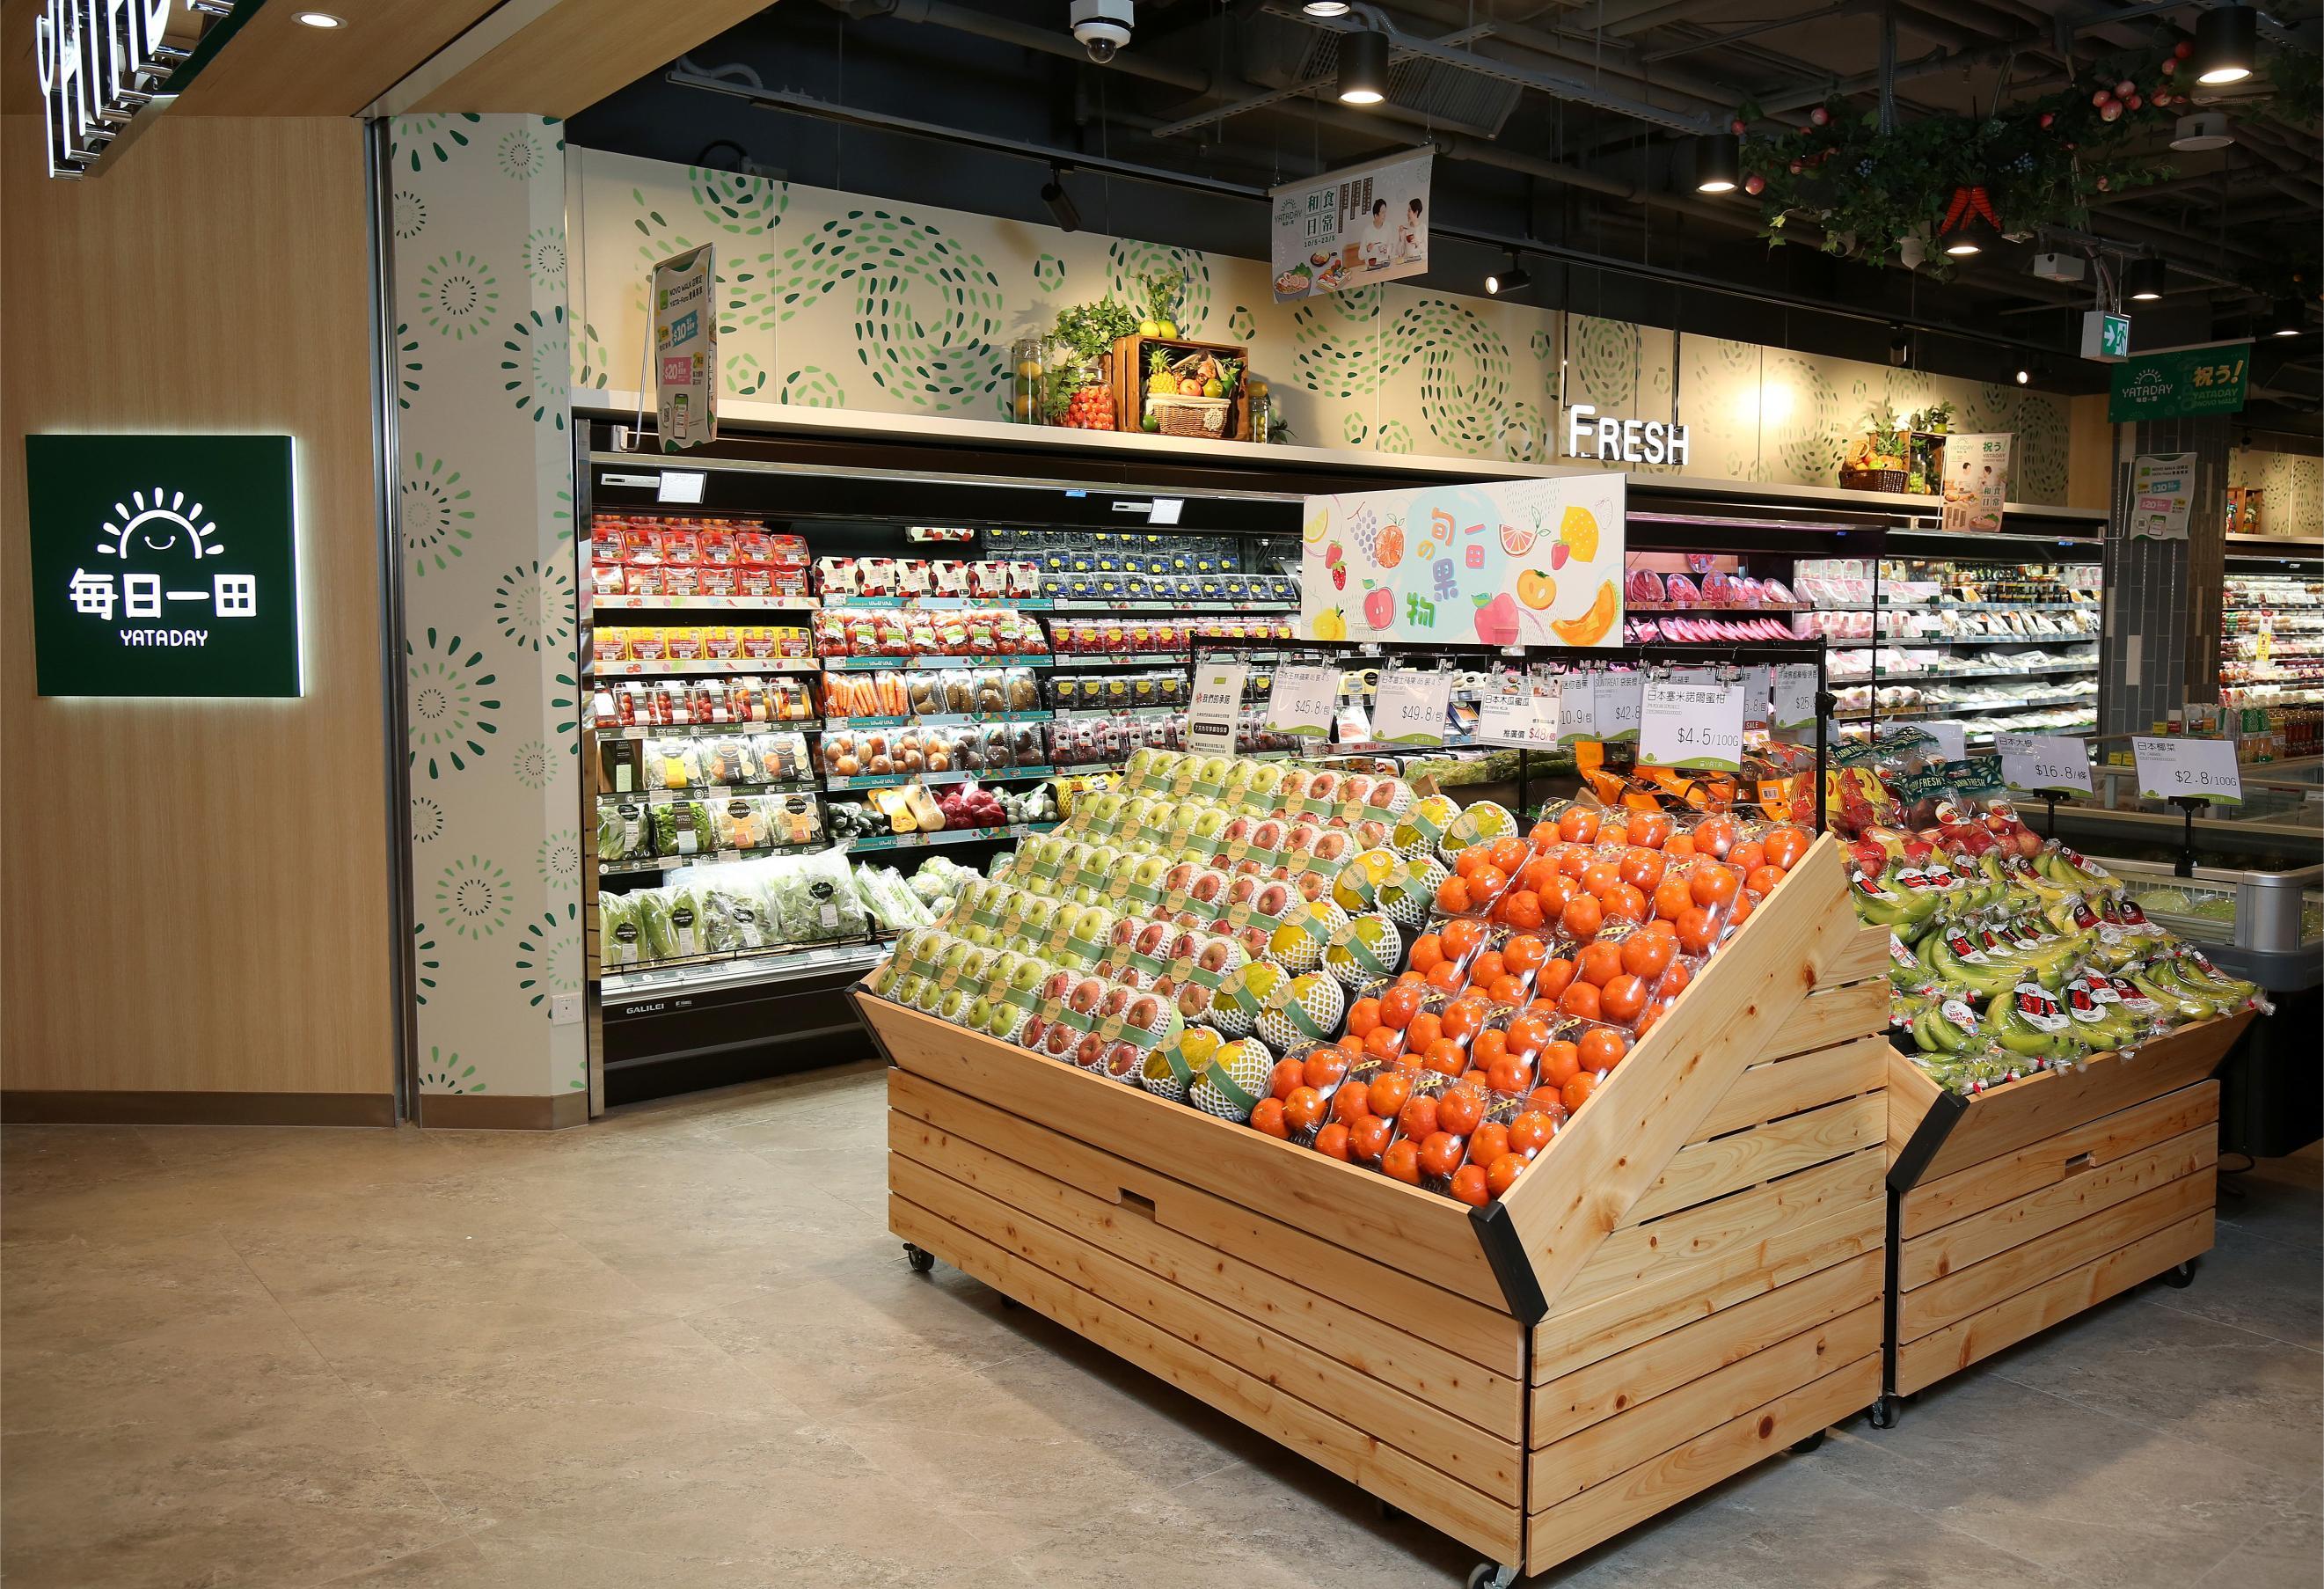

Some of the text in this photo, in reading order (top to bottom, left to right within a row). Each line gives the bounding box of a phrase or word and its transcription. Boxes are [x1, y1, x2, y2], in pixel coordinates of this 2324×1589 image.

[1308, 190, 1334, 212] 和食
[1275, 209, 1303, 223] YATADAY
[1307, 214, 1334, 236] 日常
[1304, 235, 1335, 248] 10/5-23/5
[2122, 384, 2174, 399] YATADAY
[1569, 404, 1689, 465] FRESH
[120, 629, 208, 647] YATADAY
[1485, 694, 1530, 707] 日本木瓜蜜瓜
[1677, 728, 1739, 747] $4.5/100G
[1999, 736, 2033, 747] 日本大根
[1918, 777, 1941, 789] FRESH
[1968, 778, 1986, 787] FRESH
[2174, 770, 2237, 787] $2.8/100G
[626, 1003, 664, 1014] GALILEI
